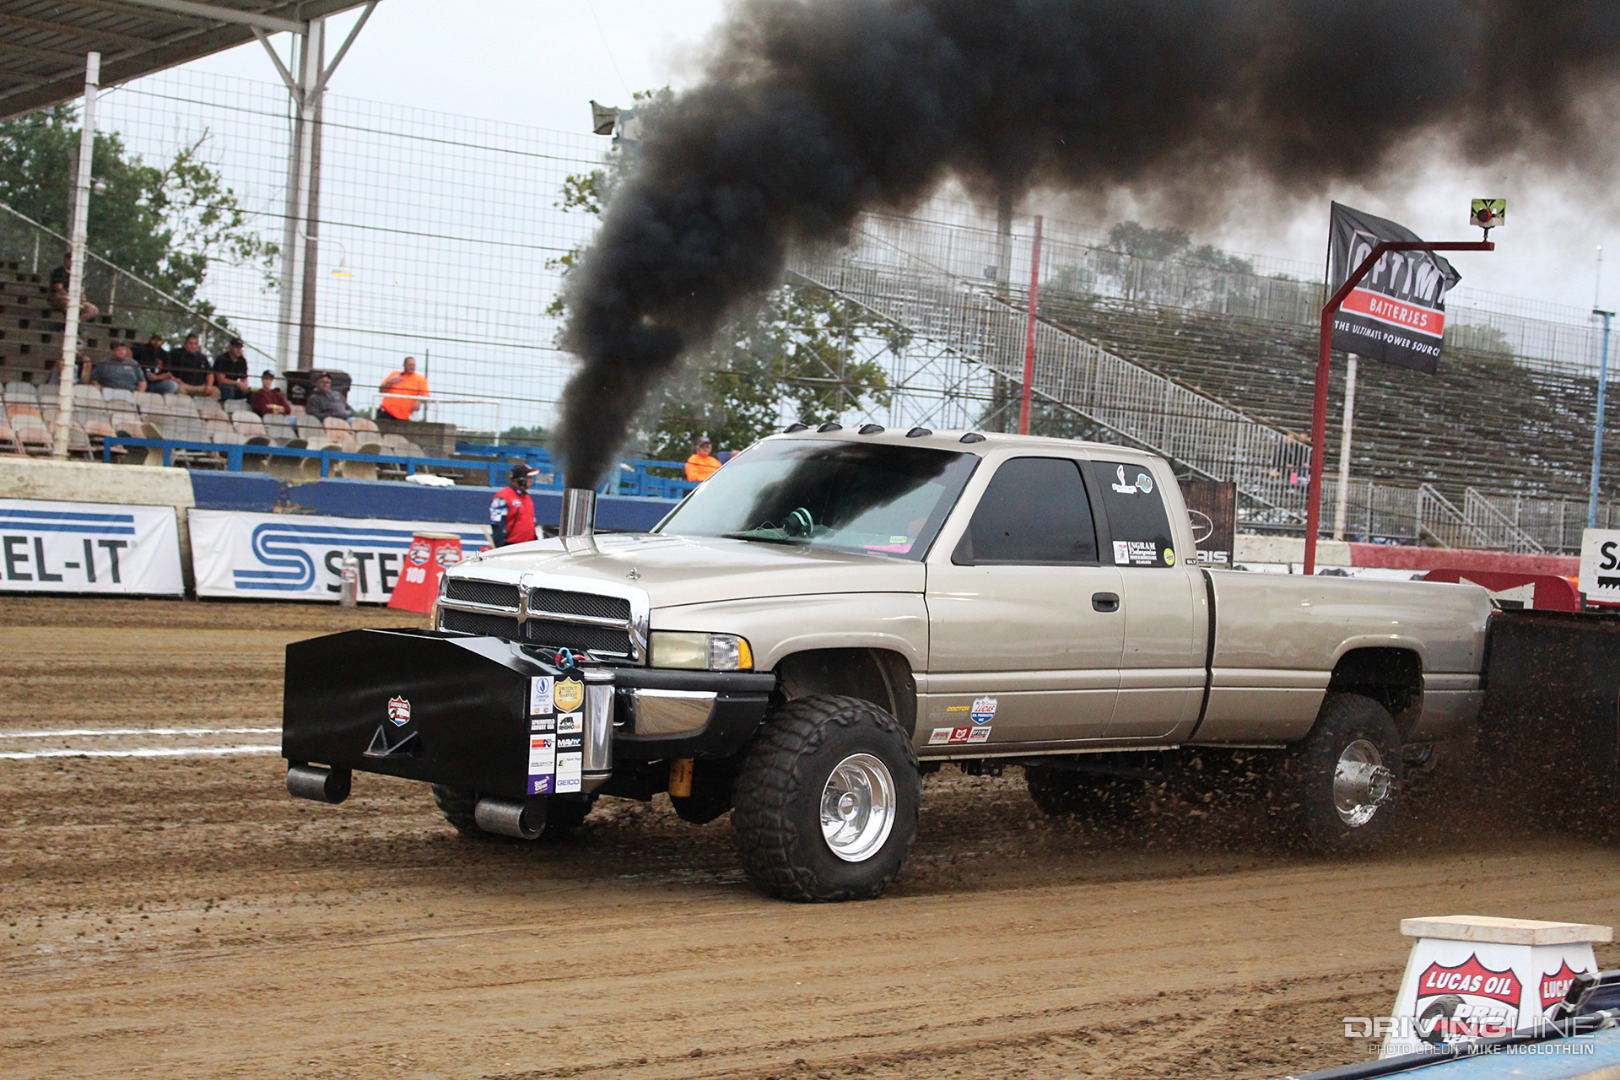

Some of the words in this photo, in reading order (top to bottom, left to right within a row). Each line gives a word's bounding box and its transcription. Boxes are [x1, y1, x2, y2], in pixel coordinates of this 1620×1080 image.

[1370, 299, 1428, 327] BATTERIES
[1334, 320, 1350, 332] THE
[1352, 324, 1382, 340] ULTIMATE
[1383, 333, 1411, 348] POWER
[405, 567, 426, 584] 100
[1426, 971, 1484, 992] LUCAS
[1484, 976, 1512, 996] OIL
